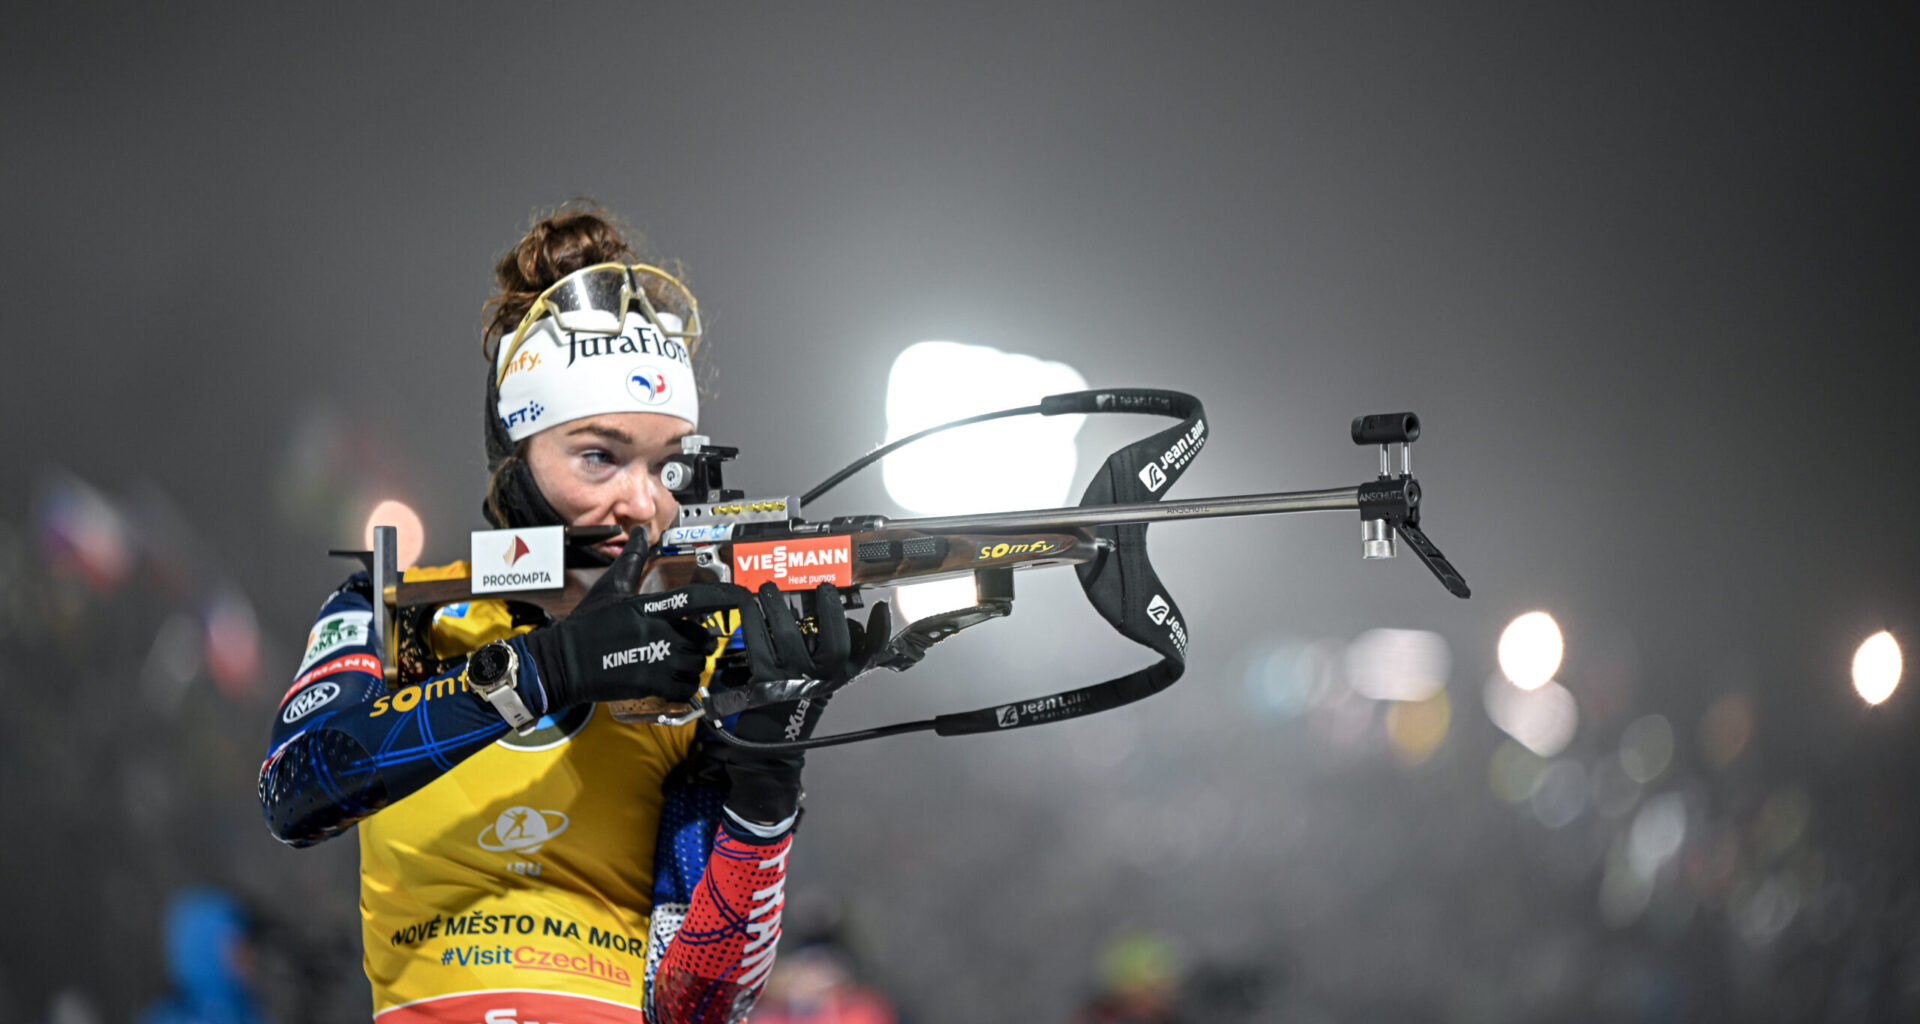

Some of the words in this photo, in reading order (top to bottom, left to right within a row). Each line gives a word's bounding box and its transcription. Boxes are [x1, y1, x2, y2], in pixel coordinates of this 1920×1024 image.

[504, 350, 542, 378] mfy.
[1160, 438, 1188, 470] Jean
[737, 546, 848, 578] VIESSMANN
[979, 541, 1055, 559] somfy
[483, 572, 551, 587] PROCOMPTA
[788, 575, 807, 585] Heat
[369, 670, 469, 717] somf
[1021, 698, 1057, 716] Jean
[1058, 692, 1090, 709] Lai
[445, 911, 535, 937] MĚSTO
[543, 917, 581, 940] NA
[589, 927, 647, 958] MOR
[441, 945, 631, 984] #VisitCzechia
